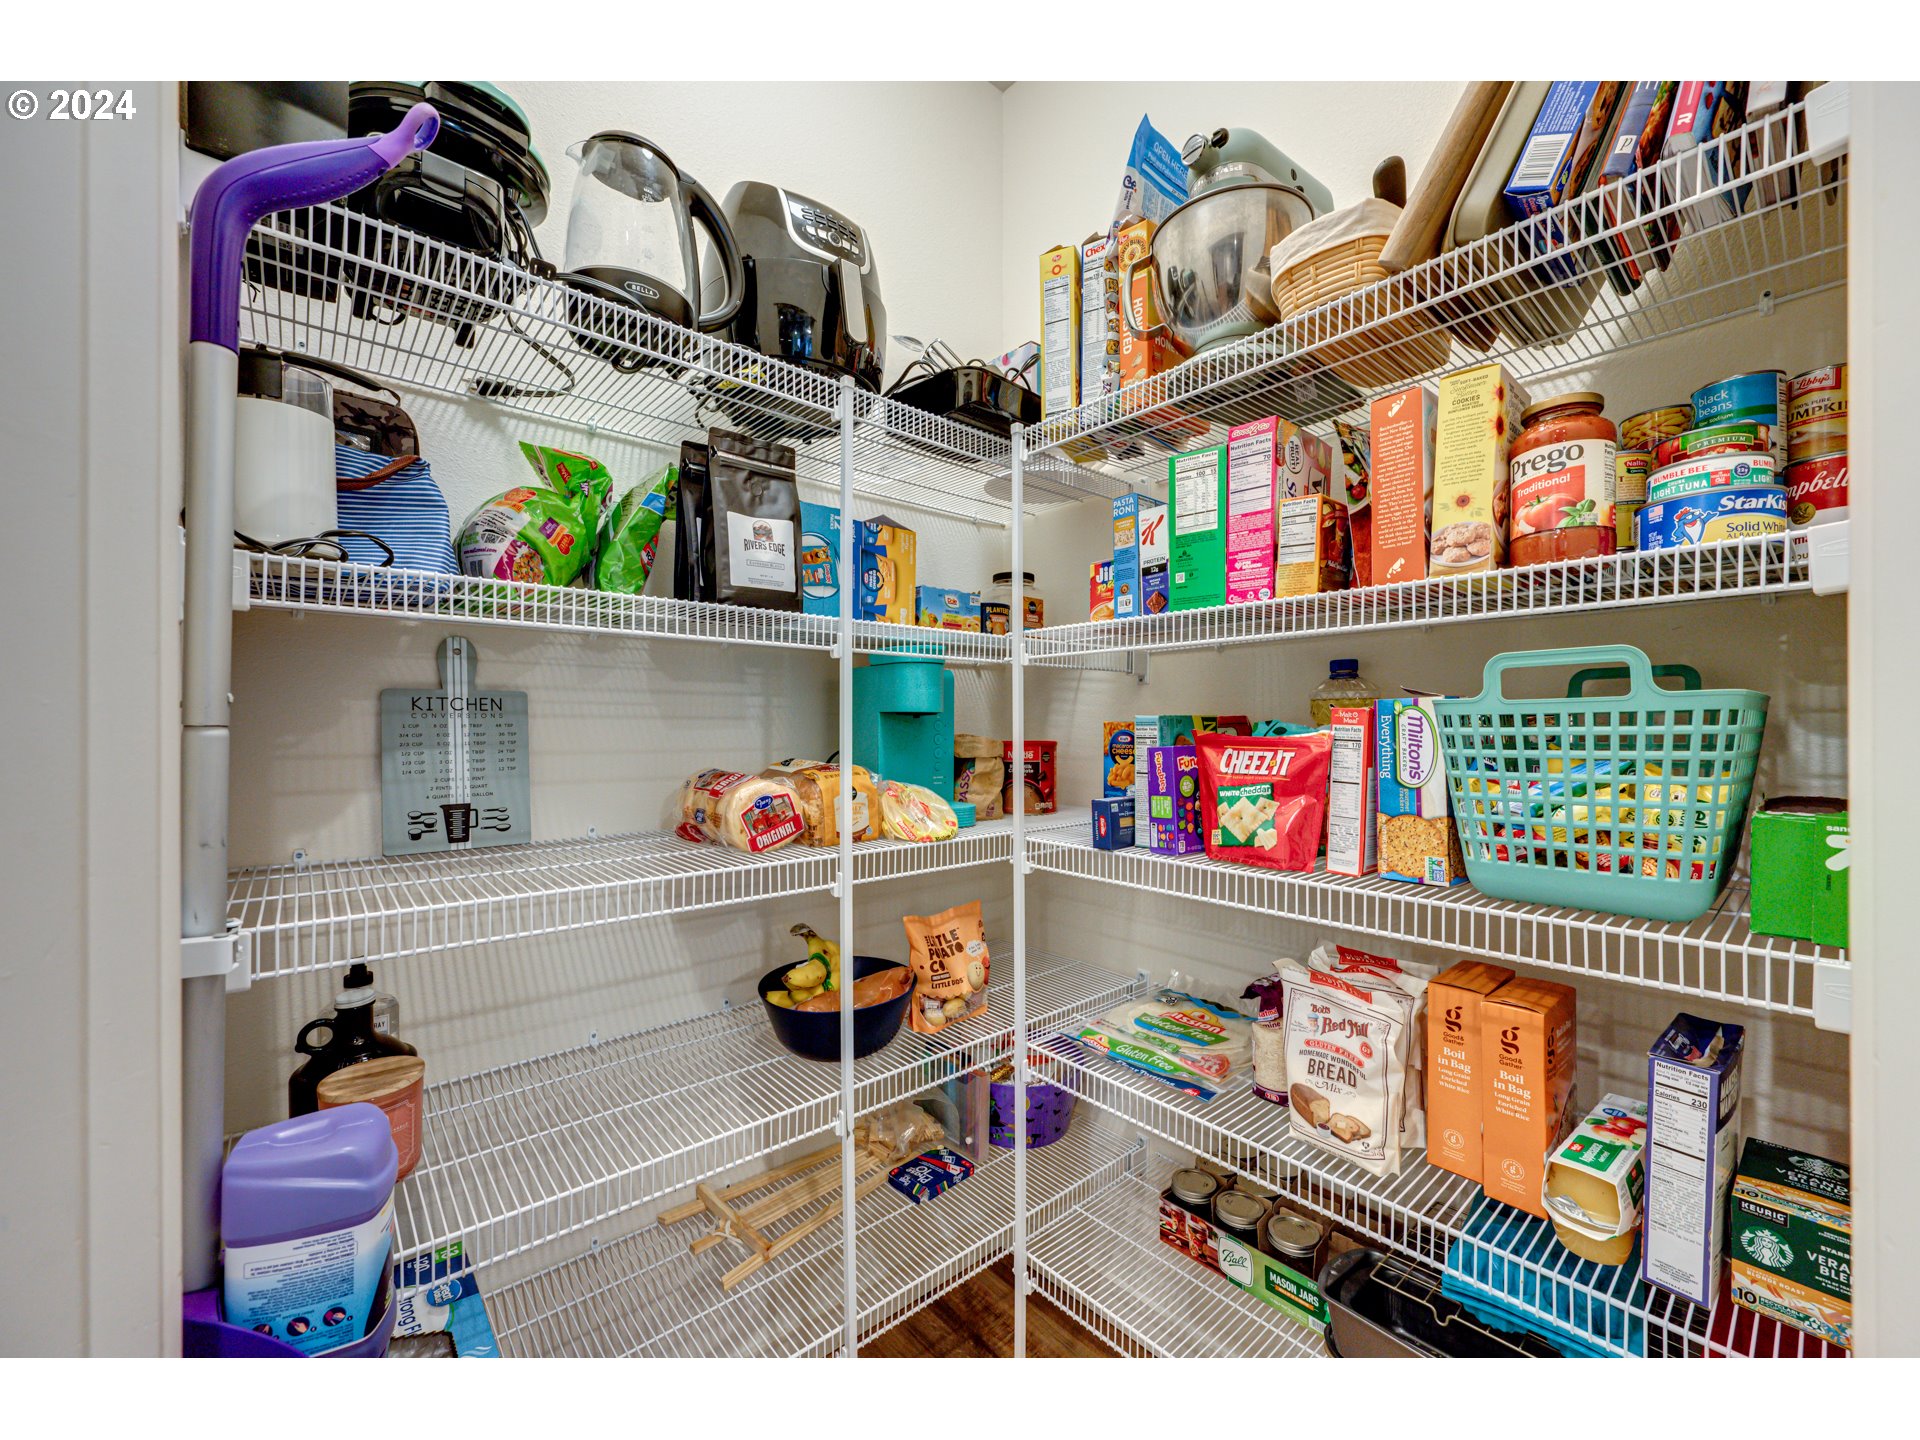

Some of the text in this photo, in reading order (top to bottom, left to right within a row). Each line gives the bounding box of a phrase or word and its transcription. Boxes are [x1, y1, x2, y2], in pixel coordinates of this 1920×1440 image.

[1154, 142, 1171, 164] OPEN
[1085, 244, 1106, 258] Chex
[1120, 243, 1130, 264] HONEY
[631, 284, 654, 297] BELLA
[1798, 373, 1831, 388] Libby's
[1452, 394, 1480, 406] COOKIES
[1698, 390, 1728, 408] black
[1811, 396, 1832, 405] PURE
[1698, 400, 1732, 418] beans
[1788, 400, 1848, 422] UMPKI
[1230, 442, 1254, 451] Nutrition
[1696, 436, 1746, 448] PREMIUM
[1176, 455, 1200, 463] Nutrition
[1511, 444, 1585, 486] Prego
[1654, 464, 1709, 485] BUMBLE BEE
[1668, 478, 1686, 487] CHUNK
[1516, 473, 1571, 500] Traditional
[1653, 485, 1676, 500] LIGHT
[1678, 479, 1709, 492] TUNA
[1114, 497, 1134, 509] PASTA
[1114, 505, 1134, 518] RONI
[1718, 494, 1786, 512] StarKis
[1142, 514, 1164, 546] K
[1726, 521, 1761, 533] Solid
[744, 538, 786, 556] RIVERS EDGE
[1143, 556, 1166, 566] PROTEIN
[411, 696, 502, 712] KITCHEN
[1380, 714, 1394, 778] Everything
[1154, 751, 1166, 792] Funables
[714, 772, 744, 791] ORIGI
[1240, 785, 1271, 796] cheddar
[756, 821, 796, 849] ORIGINAL
[932, 980, 950, 990] LITTLE
[1310, 1003, 1331, 1014] Bob's
[372, 1020, 386, 1028] RAY
[1171, 1012, 1220, 1034] ission
[1320, 1016, 1369, 1038] Red Mill
[1182, 1027, 1216, 1042] Free
[1443, 1037, 1464, 1046] Gather
[1116, 1044, 1174, 1070] Gluten Free
[1310, 1041, 1358, 1062] GLUTEN FREE
[1444, 1046, 1466, 1060] Boil
[1298, 1049, 1368, 1080] HOMEMADE WONDERFUL
[1308, 1058, 1358, 1088] BREAD
[1438, 1054, 1472, 1074] in Bag
[1438, 1066, 1471, 1080] Long Grain
[1498, 1060, 1522, 1070] Gather
[1656, 1062, 1709, 1082] Nutrition Facts
[1441, 1075, 1468, 1086] Enriched
[1500, 1070, 1524, 1085] Boil
[1315, 1080, 1342, 1094] Mix
[1438, 1080, 1470, 1094] White Rice
[1493, 1078, 1532, 1100] in Bag
[1494, 1092, 1530, 1106] Long Grain
[1498, 1100, 1527, 1113] Enriched
[1654, 1090, 1708, 1109] Calories 230
[1496, 1106, 1530, 1122] White Rice
[906, 1166, 933, 1184] Phase
[916, 1166, 932, 1176] 10
[1741, 1201, 1786, 1221] KEURIG
[1222, 1248, 1248, 1268] Ball
[1820, 1245, 1850, 1260] STARB
[1806, 1250, 1850, 1274] VERA
[1746, 1270, 1806, 1296] BLONDE ROAST
[1820, 1266, 1848, 1283] BLE
[440, 1282, 454, 1301] Great
[1269, 1271, 1298, 1294] MASON
[1298, 1288, 1320, 1307] JARS
[1737, 1287, 1758, 1304] 10
[398, 1296, 416, 1327] trong
[1760, 1297, 1804, 1318] RECYCLABLE
